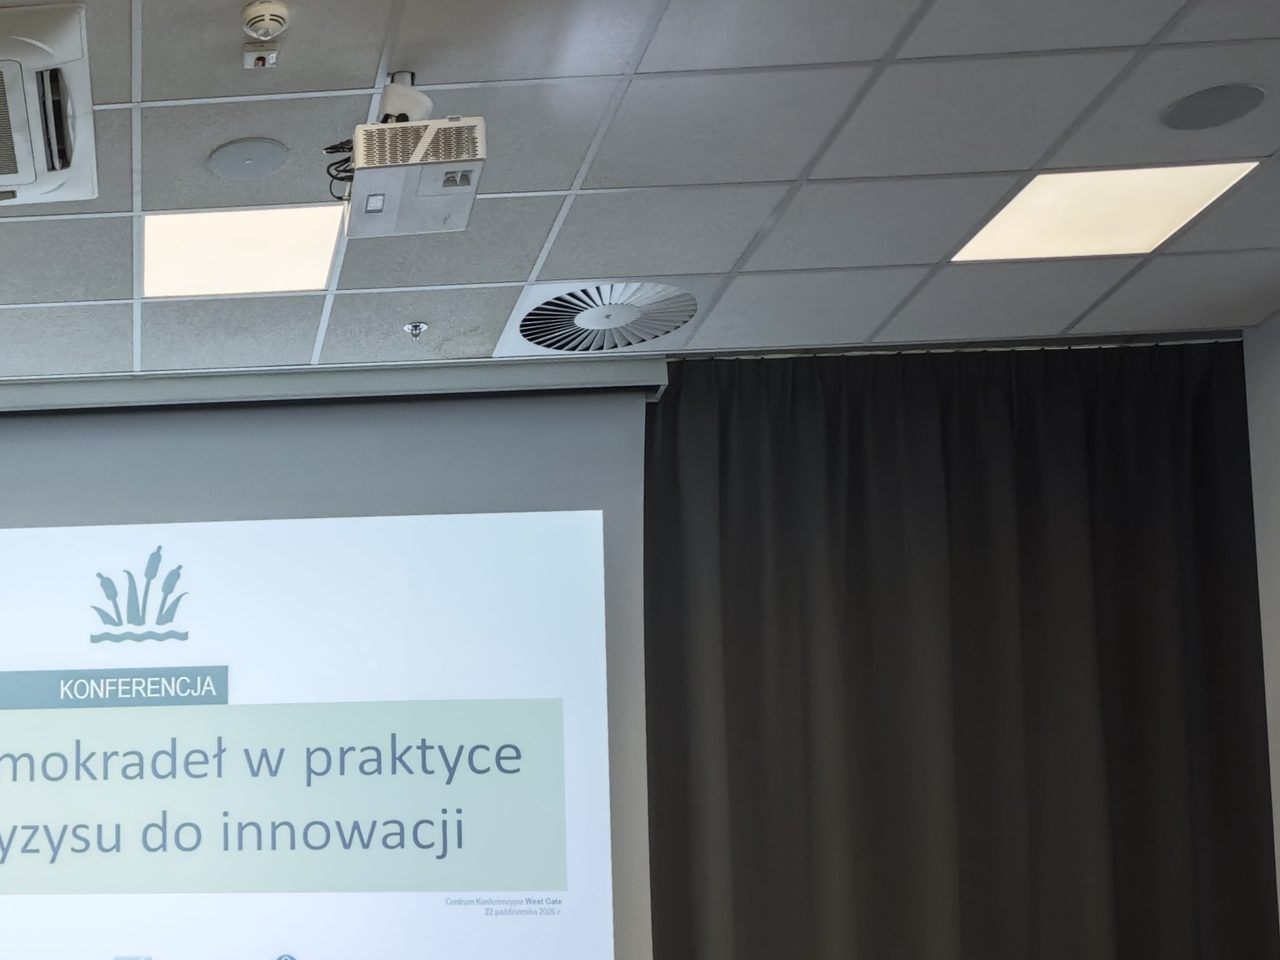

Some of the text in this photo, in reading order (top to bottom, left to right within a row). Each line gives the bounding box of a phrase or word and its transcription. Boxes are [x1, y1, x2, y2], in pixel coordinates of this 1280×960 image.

[59, 676, 217, 699] KONFERENCJA
[243, 747, 285, 777] w
[305, 733, 522, 787] praktyce
[141, 810, 202, 852] do
[223, 808, 463, 860] innowacji
[525, 897, 544, 906] West
